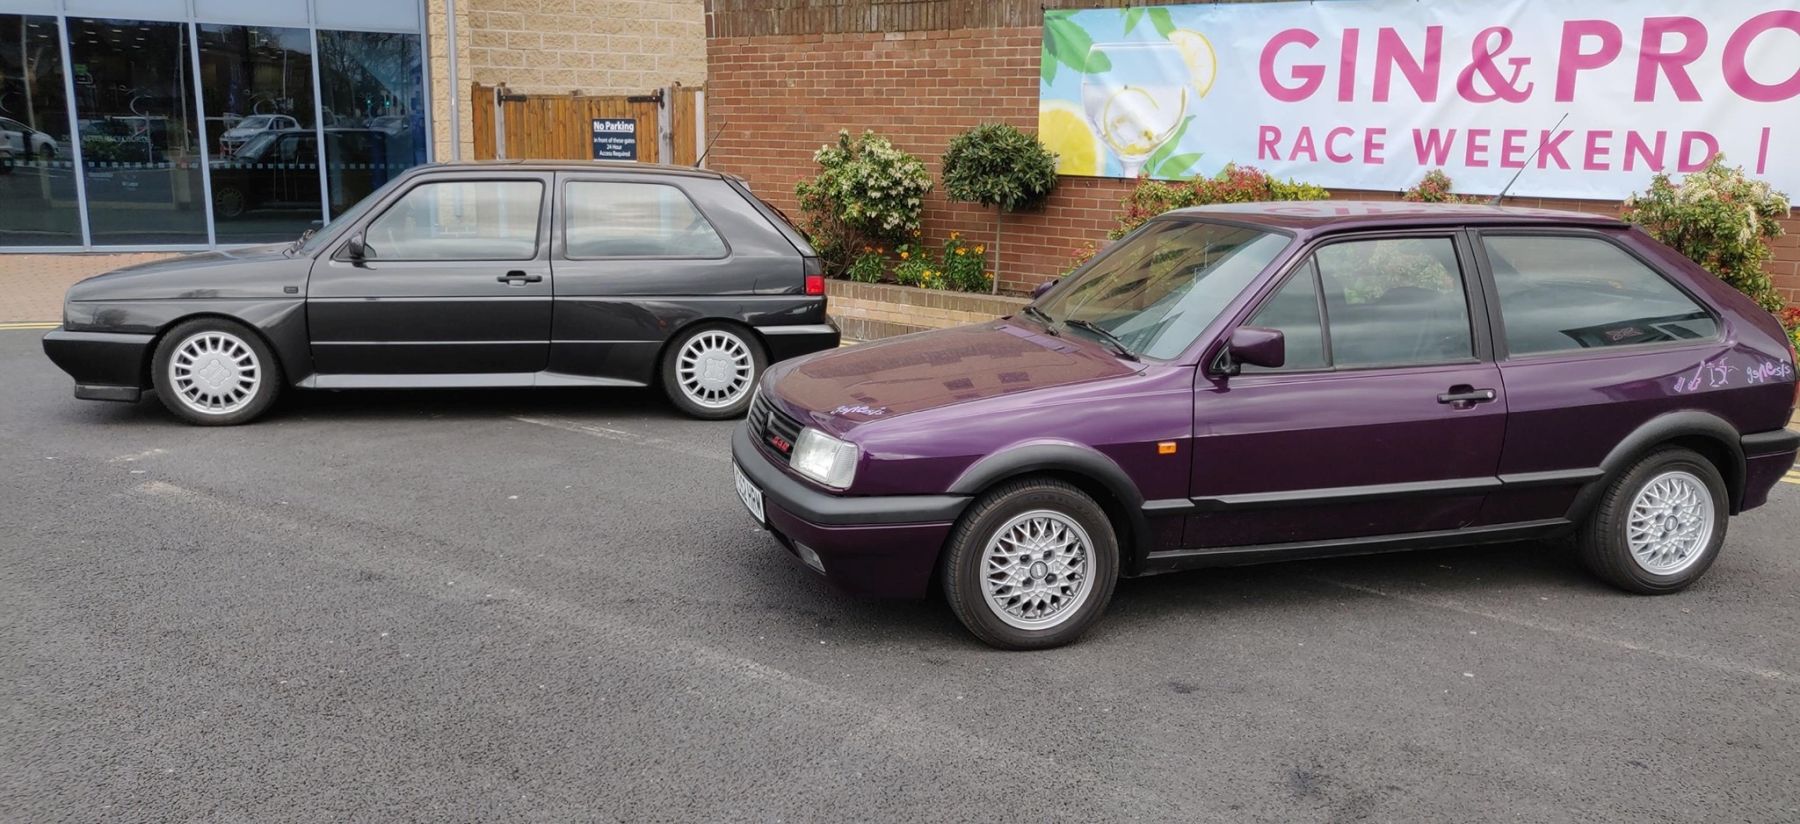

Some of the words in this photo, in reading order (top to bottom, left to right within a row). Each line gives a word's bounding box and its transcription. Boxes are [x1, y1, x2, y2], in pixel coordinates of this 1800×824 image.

[593, 121, 604, 131] No
[605, 121, 634, 133] Parking
[1258, 125, 1387, 165] RACE
[1412, 127, 1720, 173] WEEKEND
